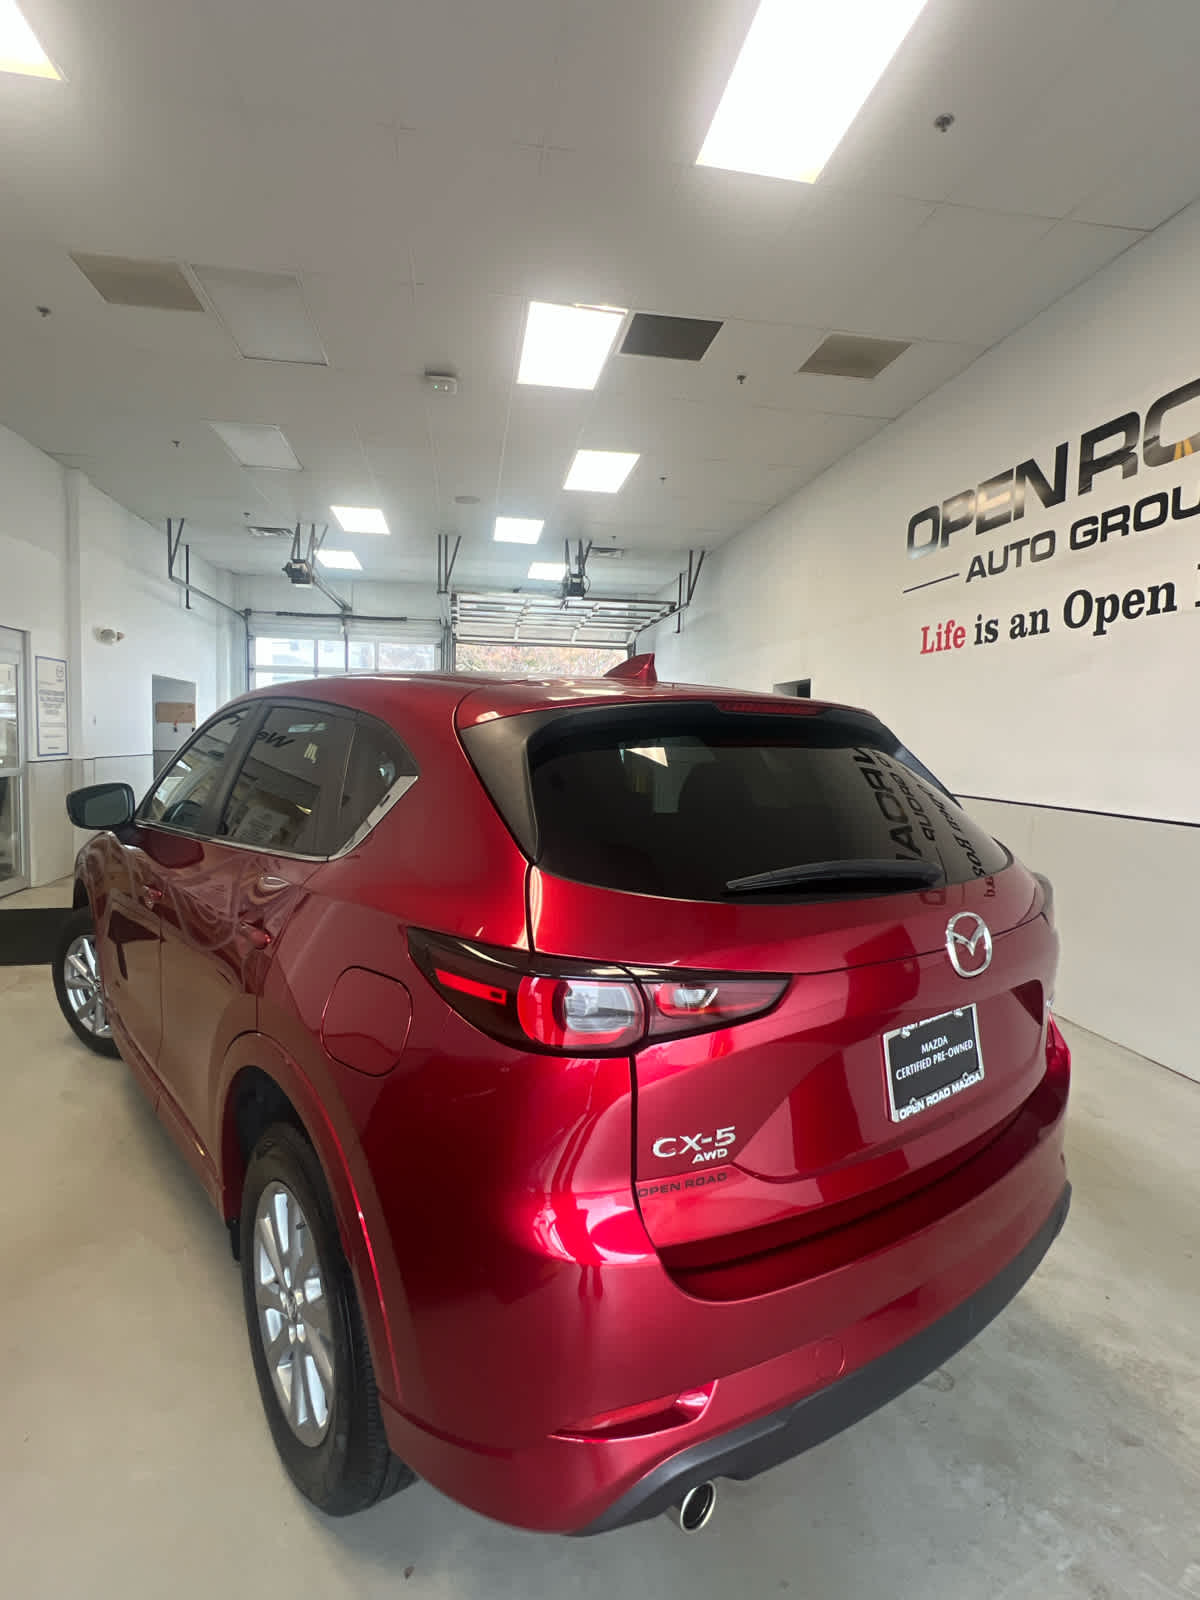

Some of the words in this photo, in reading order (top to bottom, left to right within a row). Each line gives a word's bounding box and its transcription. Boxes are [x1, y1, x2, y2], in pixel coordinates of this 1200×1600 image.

[907, 441, 1069, 560] OPEN
[965, 529, 1056, 583] AUTO
[920, 619, 966, 655] Life
[974, 614, 999, 645] is
[1009, 607, 1050, 640] an
[1063, 581, 1178, 637] Open
[895, 1057, 931, 1080] CERTIFIED
[933, 1039, 974, 1064] PRE-OWNED
[921, 1035, 949, 1054] MAZDA
[899, 1099, 925, 1120] OPEN
[926, 1087, 951, 1106] ROAD
[951, 1072, 981, 1094] MAZDA
[652, 1126, 736, 1158] CX-5
[692, 1148, 728, 1164] AWD
[638, 1182, 681, 1198] OPEN
[684, 1172, 728, 1190] ROAD
